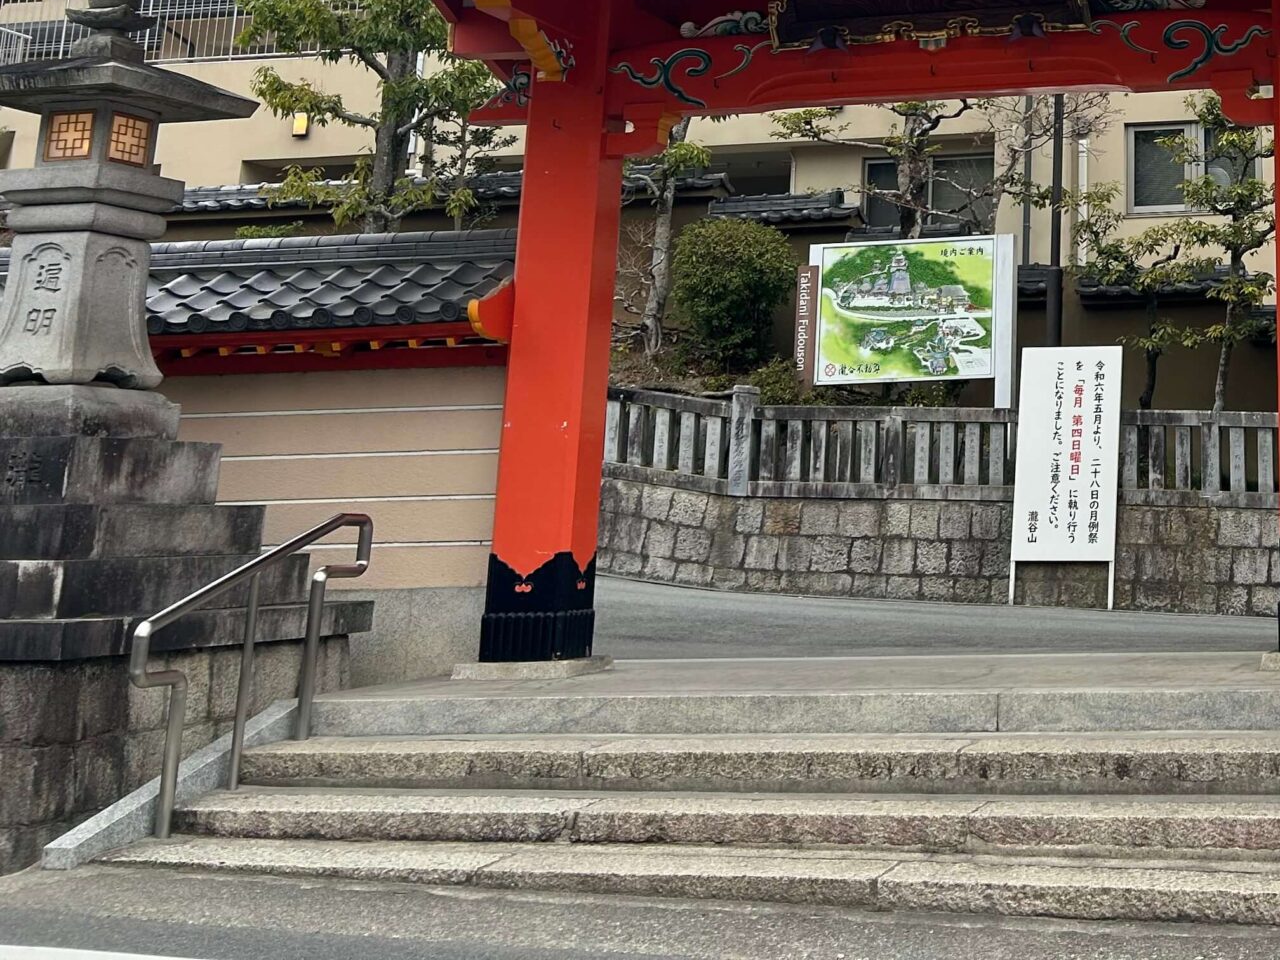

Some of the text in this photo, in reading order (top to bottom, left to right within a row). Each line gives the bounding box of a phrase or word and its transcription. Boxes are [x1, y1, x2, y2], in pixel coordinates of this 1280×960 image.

[940, 246, 984, 258] 境内ご案内
[796, 271, 812, 371] Takidani Fudouson
[1027, 510, 1039, 544] 瀧谷山
